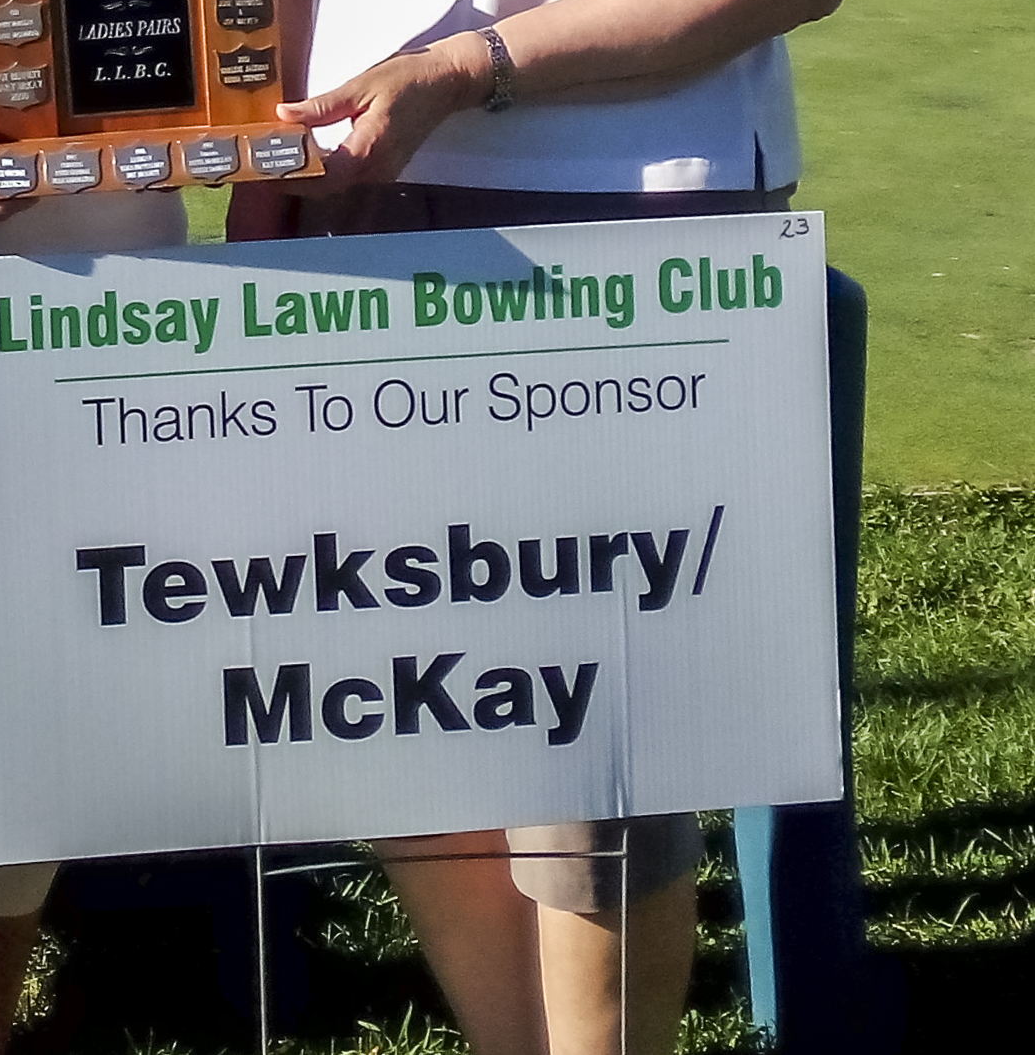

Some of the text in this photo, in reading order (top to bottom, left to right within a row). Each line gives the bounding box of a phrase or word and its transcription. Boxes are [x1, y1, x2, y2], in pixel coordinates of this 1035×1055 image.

[78, 17, 182, 41] LADIES PAIRS
[778, 218, 810, 240] 23
[243, 283, 389, 337] Lawn
[413, 264, 635, 330] Bowling
[659, 254, 782, 313] Club
[82, 373, 705, 445] Thanks To Our Sponsor
[76, 506, 724, 625] Tewksbury/
[223, 652, 599, 746] McKay
